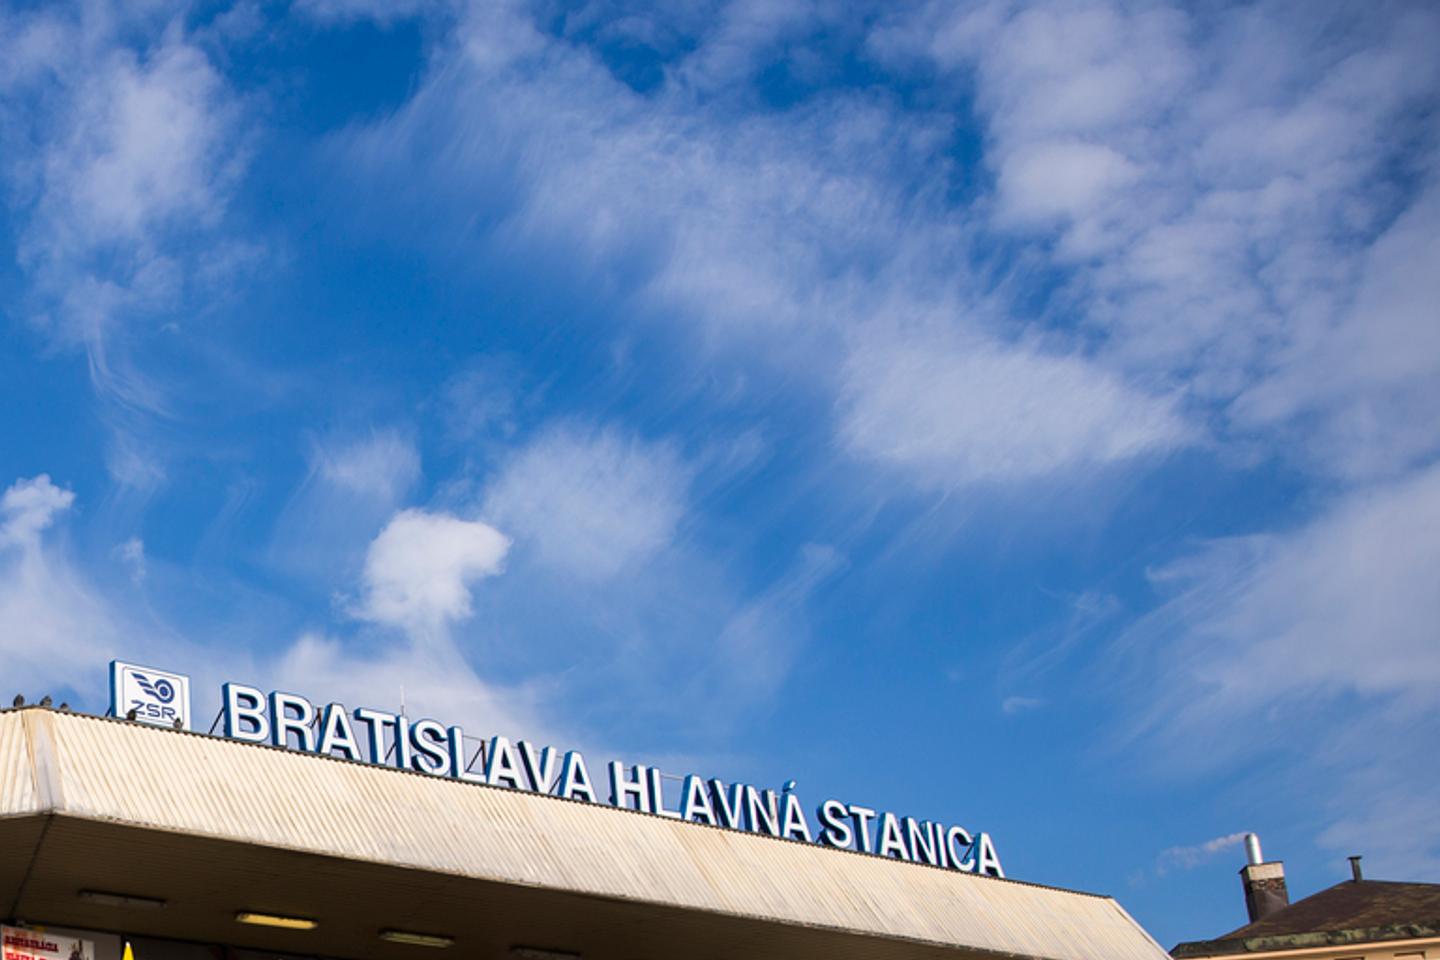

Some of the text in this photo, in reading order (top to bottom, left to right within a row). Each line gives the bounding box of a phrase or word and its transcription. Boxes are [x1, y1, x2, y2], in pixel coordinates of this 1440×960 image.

[222, 682, 1006, 879] BRATISLAVA HLAVNÁ STANICA
